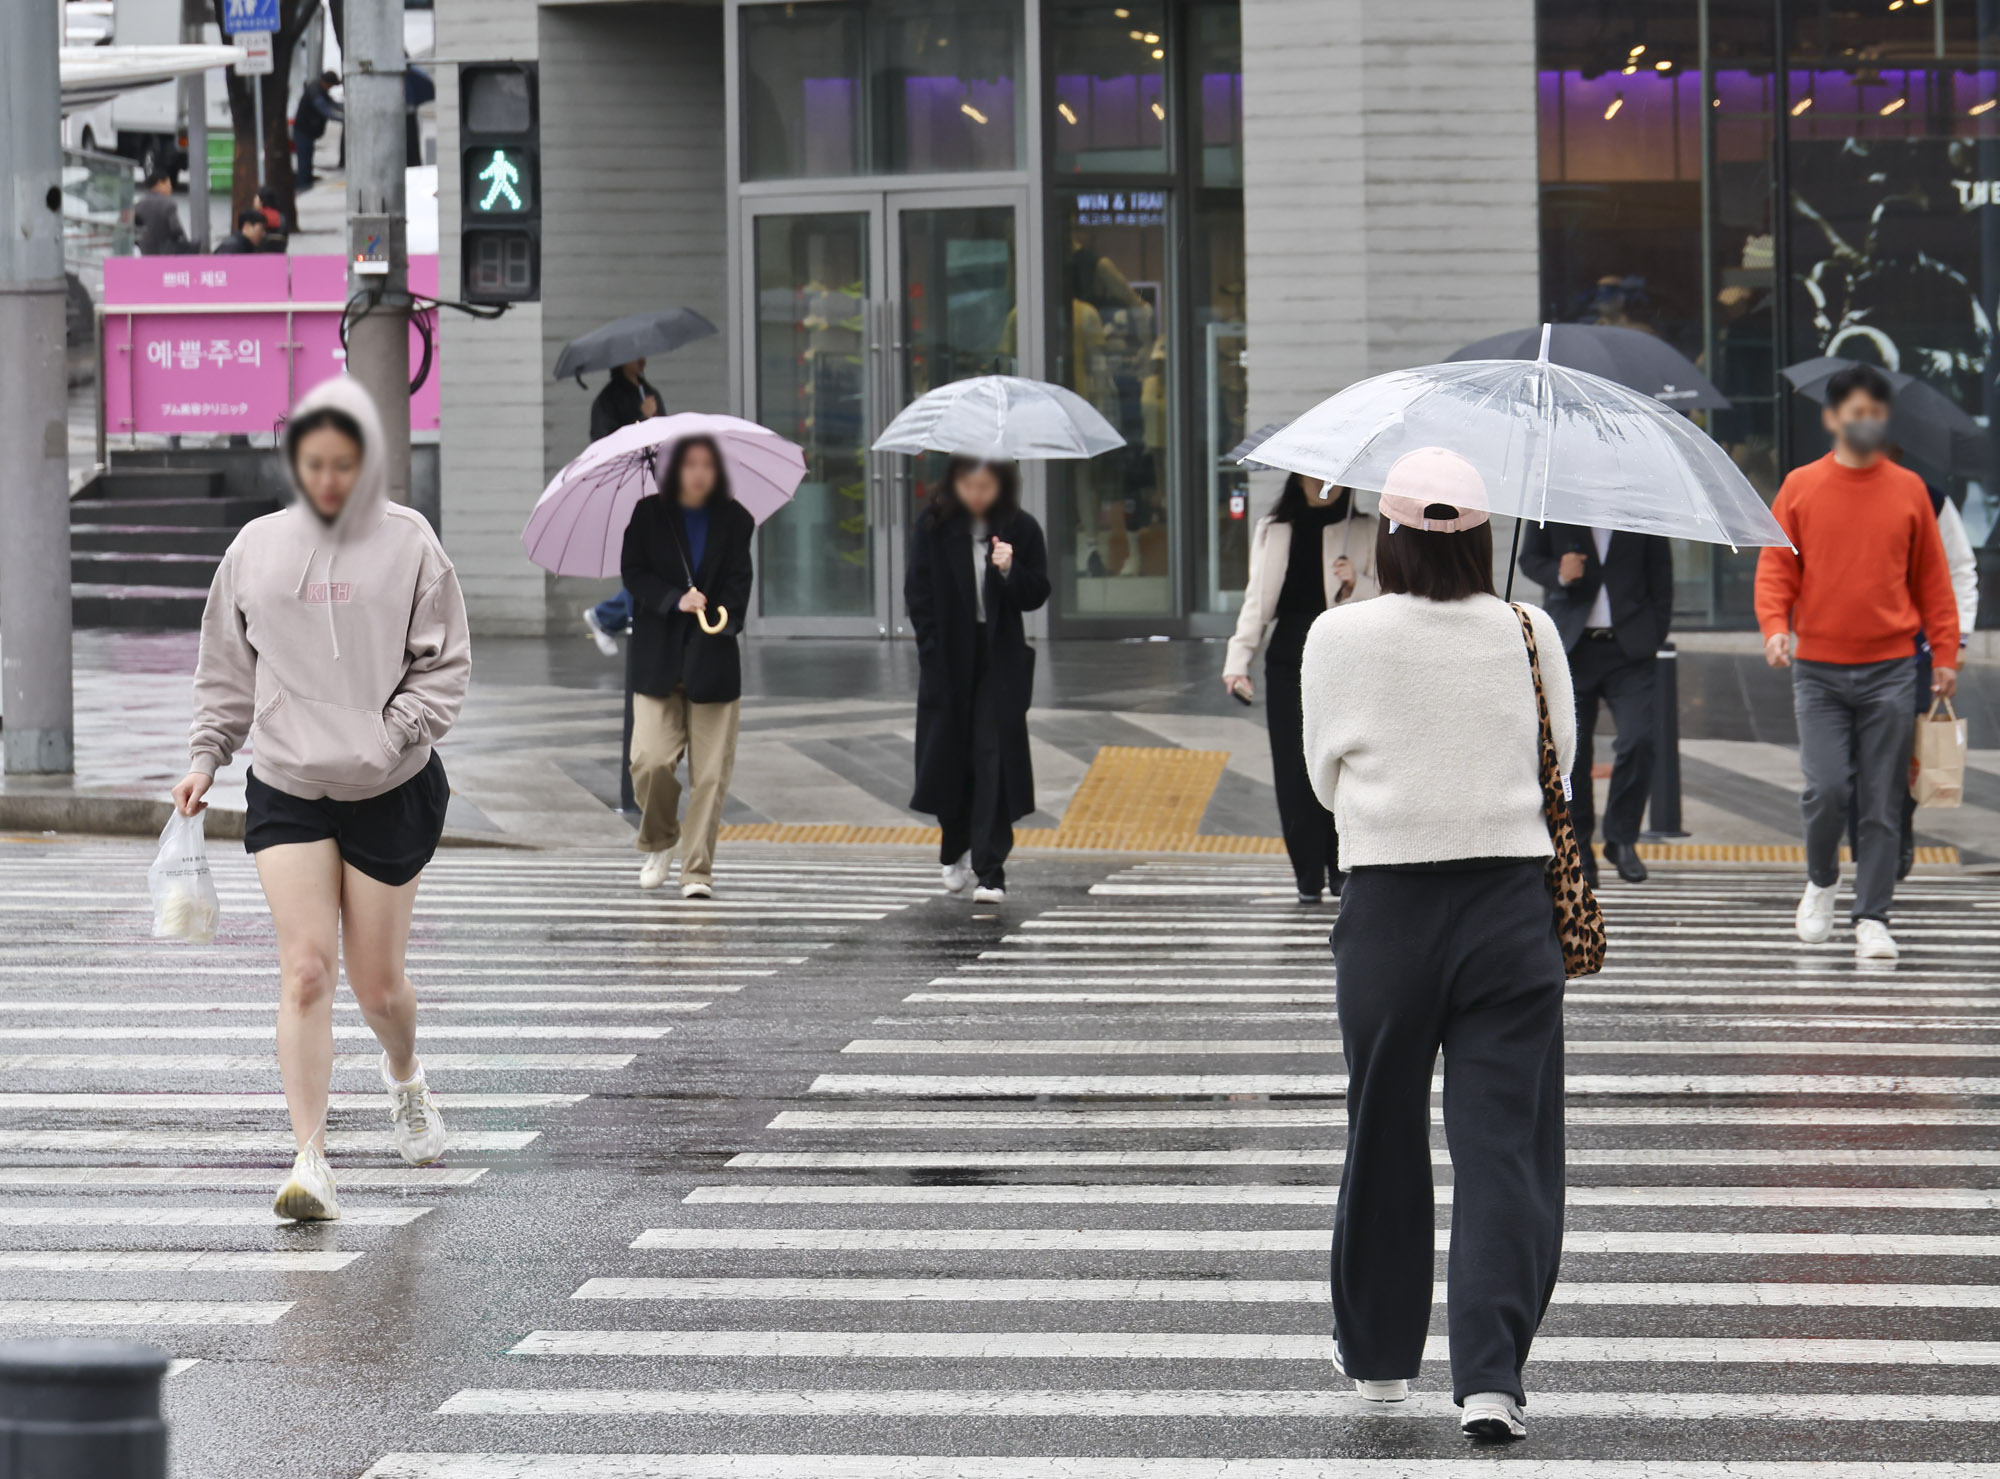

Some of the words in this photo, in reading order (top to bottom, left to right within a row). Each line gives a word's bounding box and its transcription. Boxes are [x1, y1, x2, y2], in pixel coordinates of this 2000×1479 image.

[1077, 193, 1109, 210] WIN
[1112, 193, 1126, 211] &
[163, 270, 190, 288] 쁘띠
[200, 270, 228, 288] 제모
